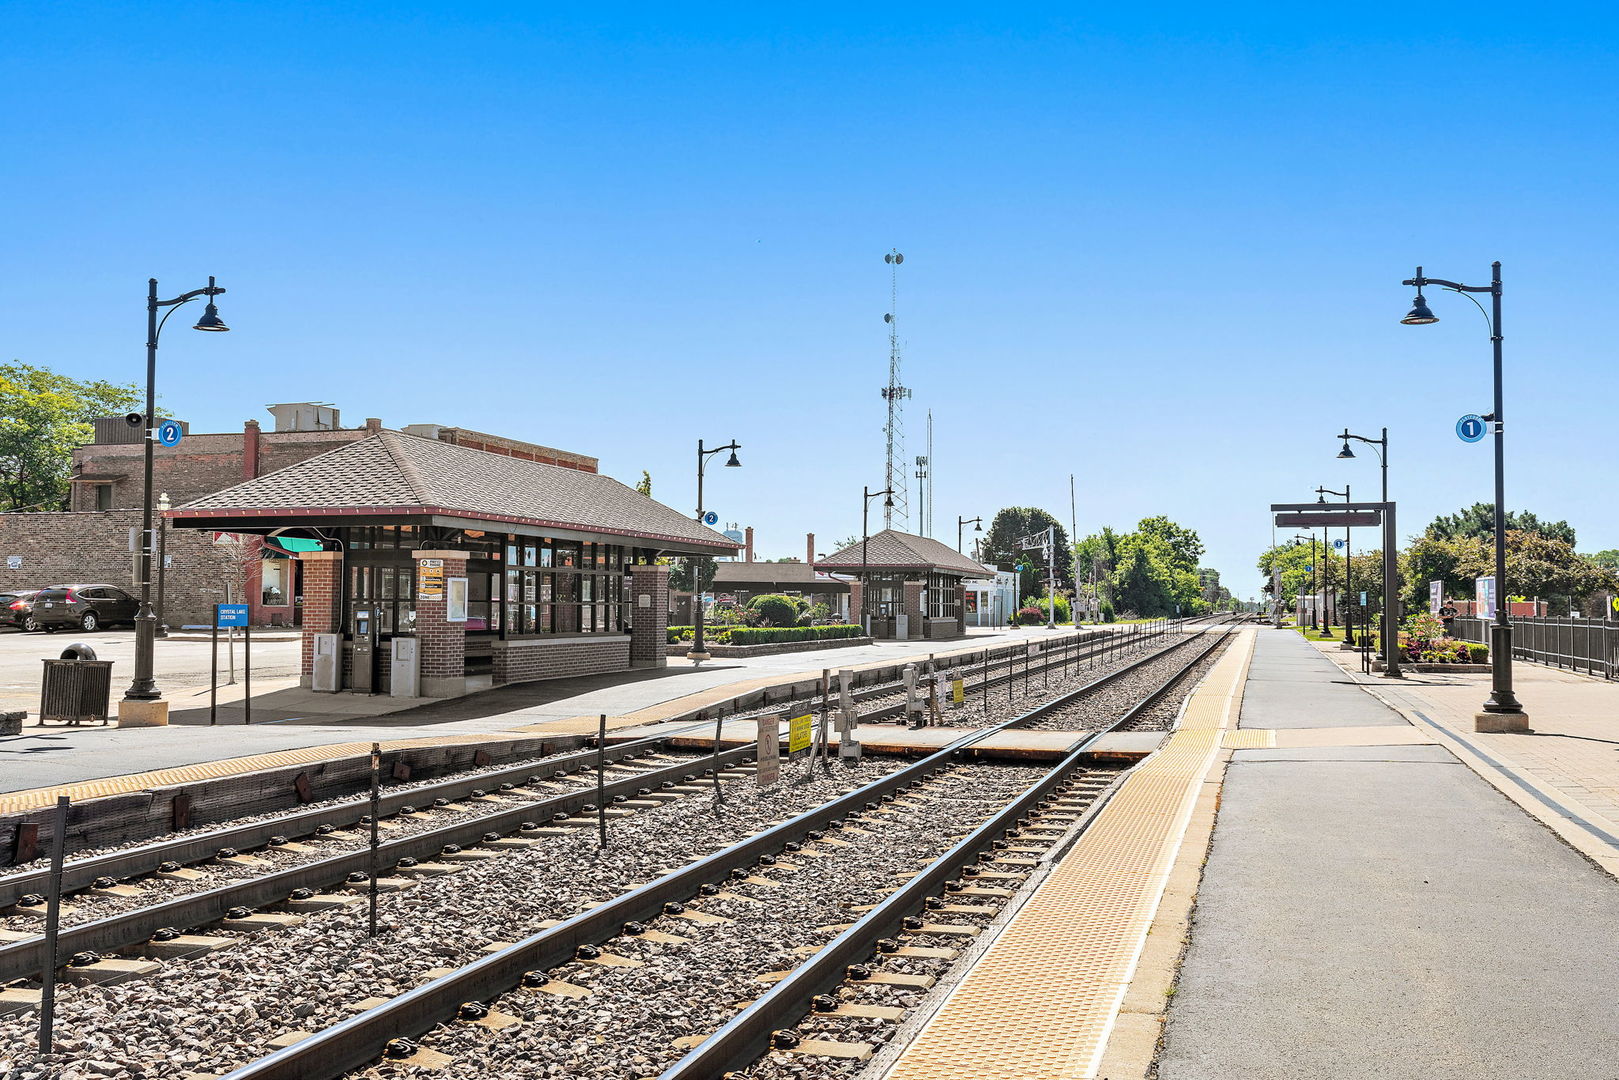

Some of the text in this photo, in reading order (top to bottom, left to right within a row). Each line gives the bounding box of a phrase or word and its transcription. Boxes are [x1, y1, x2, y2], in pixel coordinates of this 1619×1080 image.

[166, 427, 175, 441] 2
[1467, 422, 1474, 436] 1
[709, 514, 715, 523] 2
